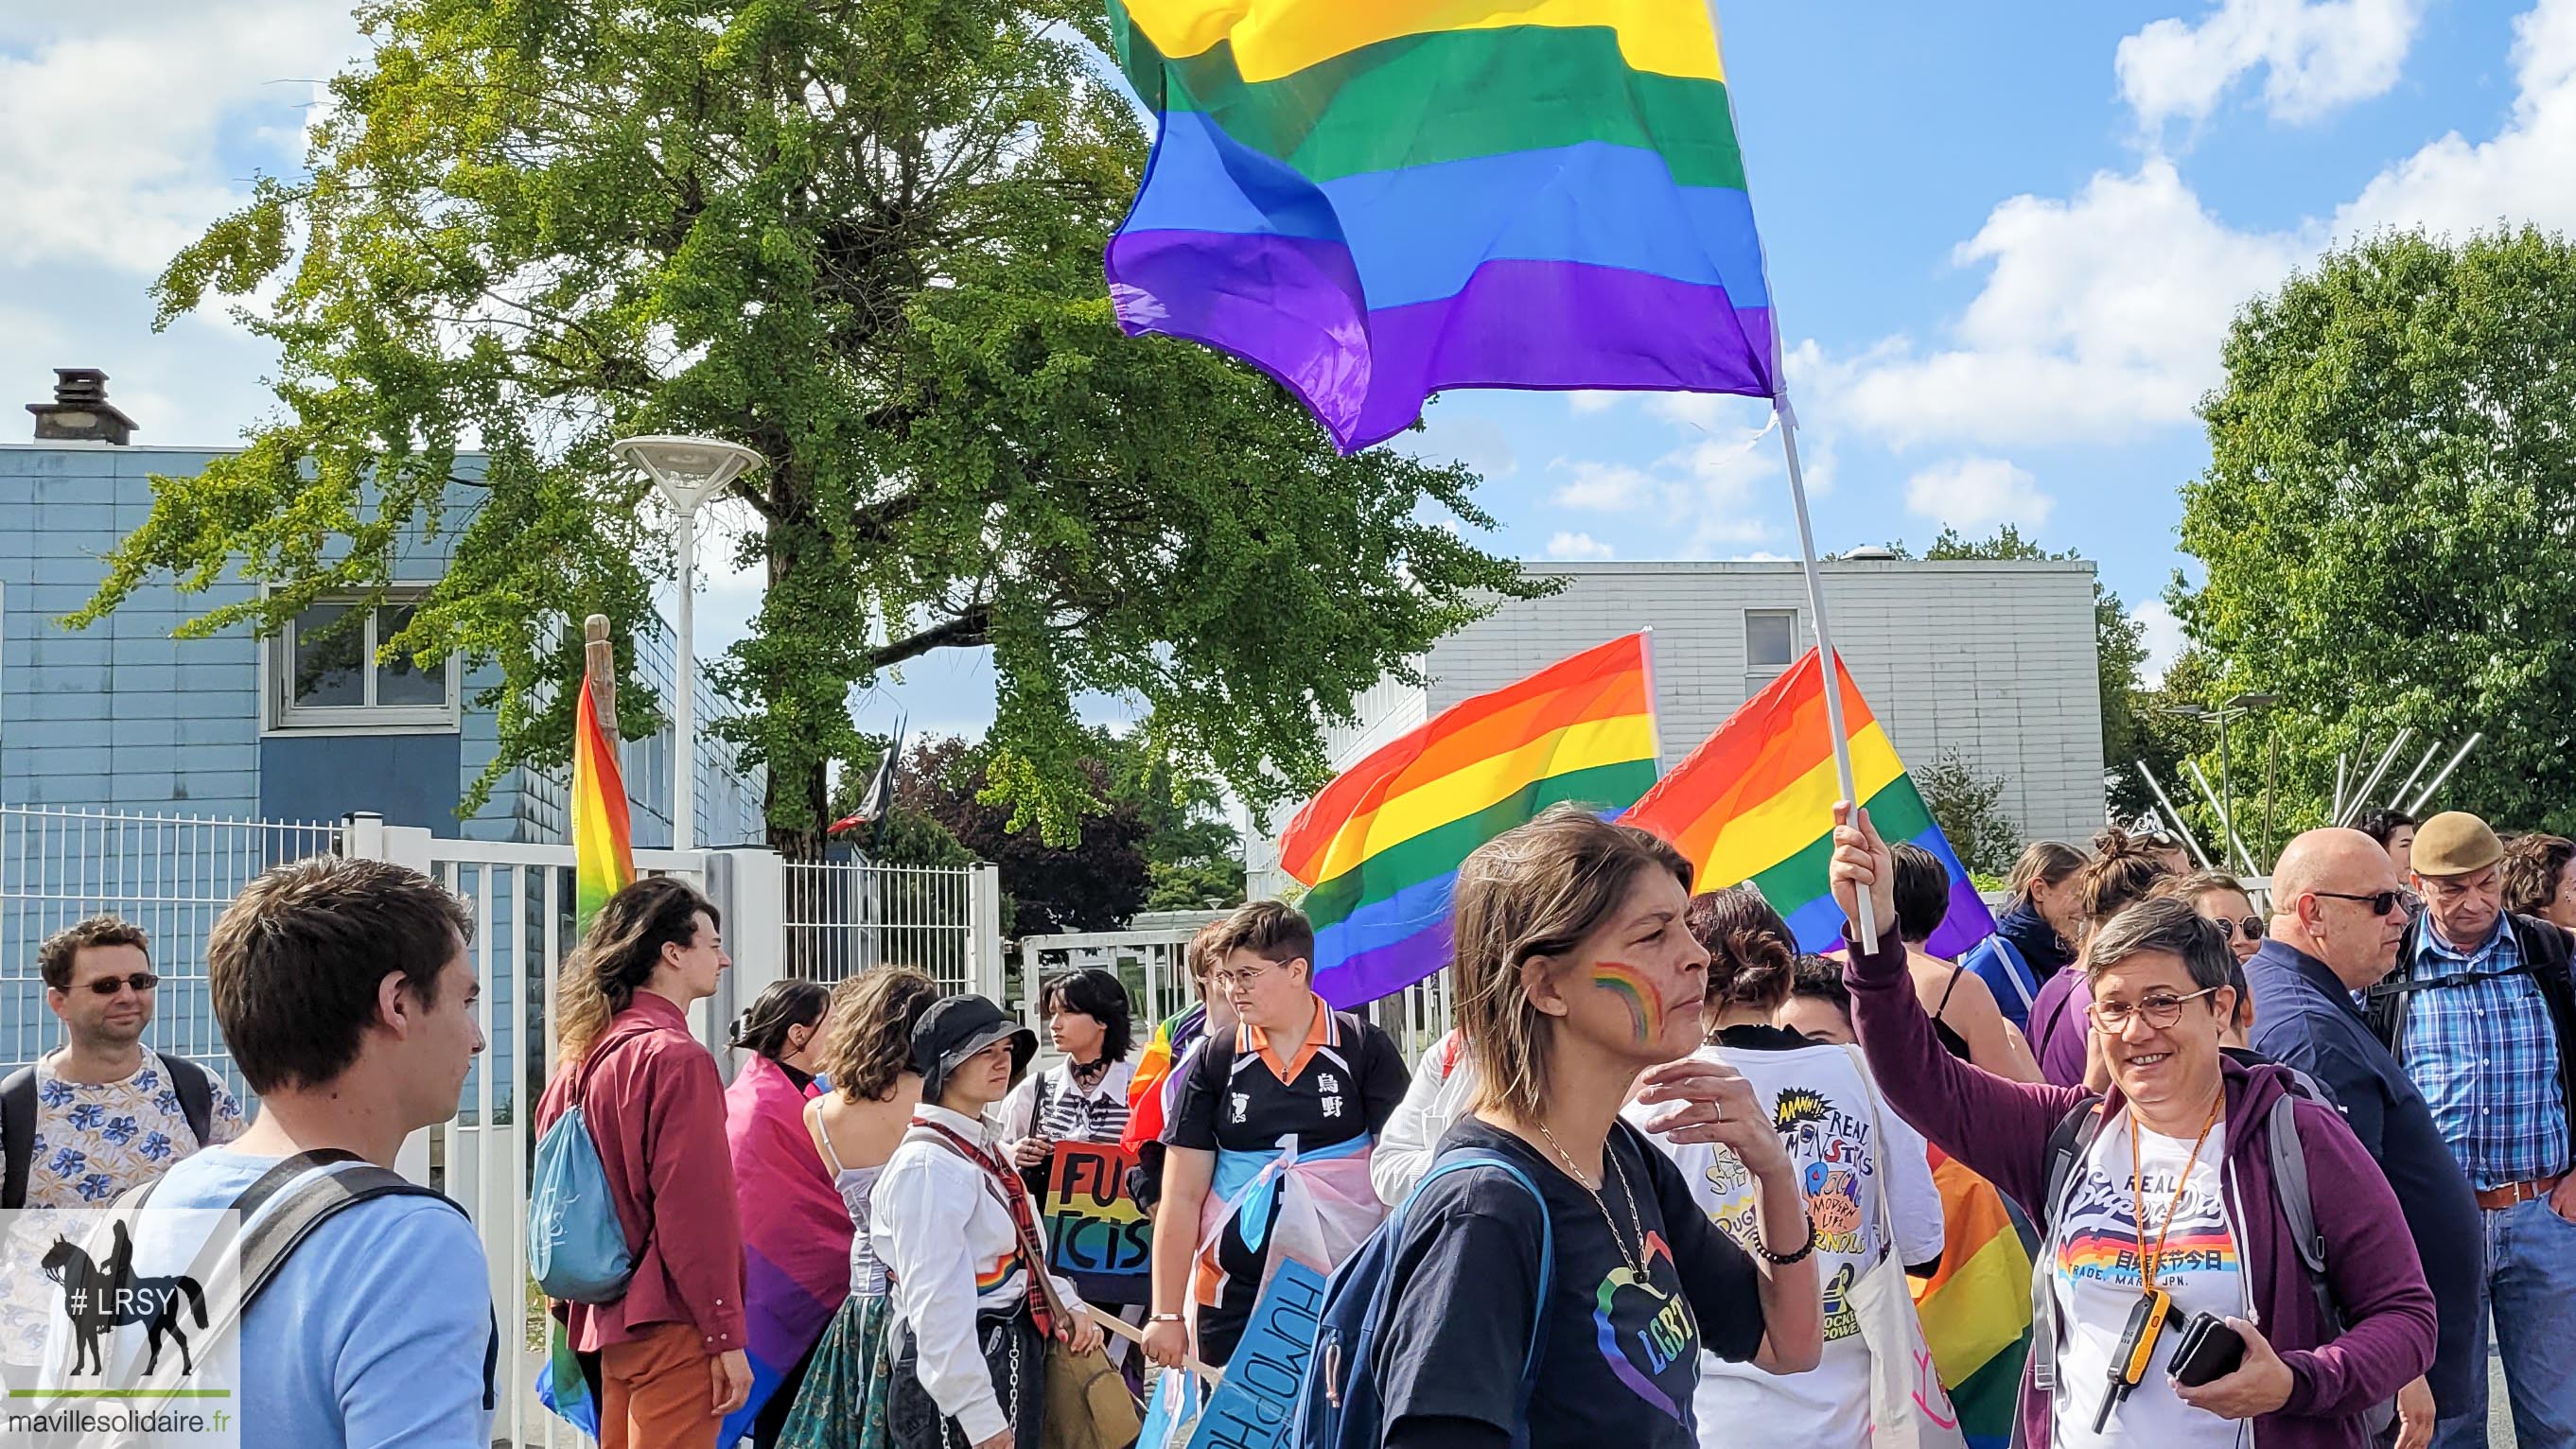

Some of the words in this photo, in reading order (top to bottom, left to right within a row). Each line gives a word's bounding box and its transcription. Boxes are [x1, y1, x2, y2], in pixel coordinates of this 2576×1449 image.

[1829, 1110, 1869, 1146] REAL
[1060, 1153, 1123, 1208] FU
[2124, 1176, 2177, 1194] REAL
[2115, 1275, 2144, 1287] MAR
[2162, 1275, 2189, 1286] JPN.
[1637, 1292, 1693, 1376] LGBT
[1207, 1276, 1324, 1449] HUMOPH
